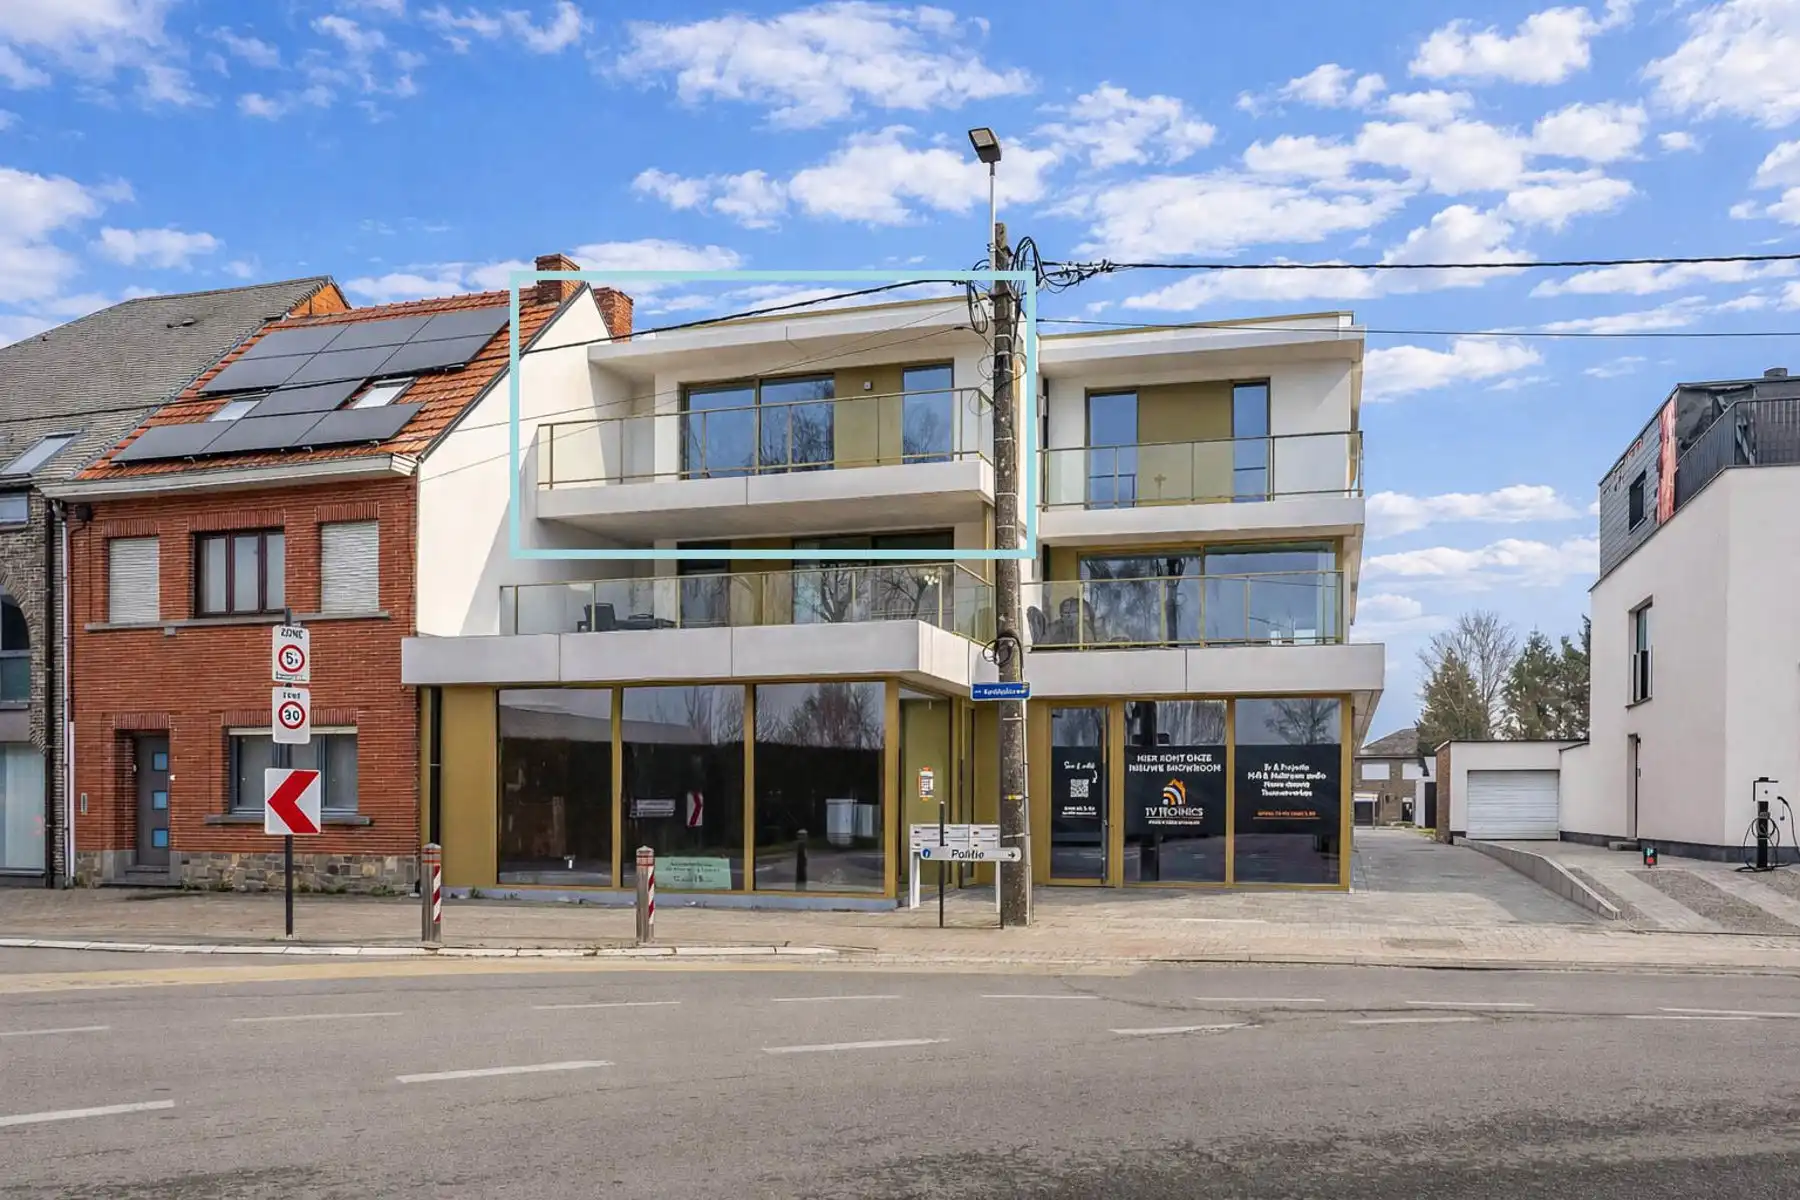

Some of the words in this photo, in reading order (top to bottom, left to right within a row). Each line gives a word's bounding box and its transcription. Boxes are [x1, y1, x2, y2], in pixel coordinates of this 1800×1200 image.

[281, 627, 303, 639] ZONE
[284, 709, 300, 721] 30
[1137, 754, 1158, 762] HIER
[1160, 754, 1185, 762] KOMT
[1186, 753, 1213, 762] ONZE
[1128, 764, 1165, 772] NIEUWE
[1166, 764, 1222, 772] SHOWROOM
[1145, 807, 1158, 817] TV
[1158, 807, 1204, 817] TRONICS
[951, 849, 985, 859] Politie
